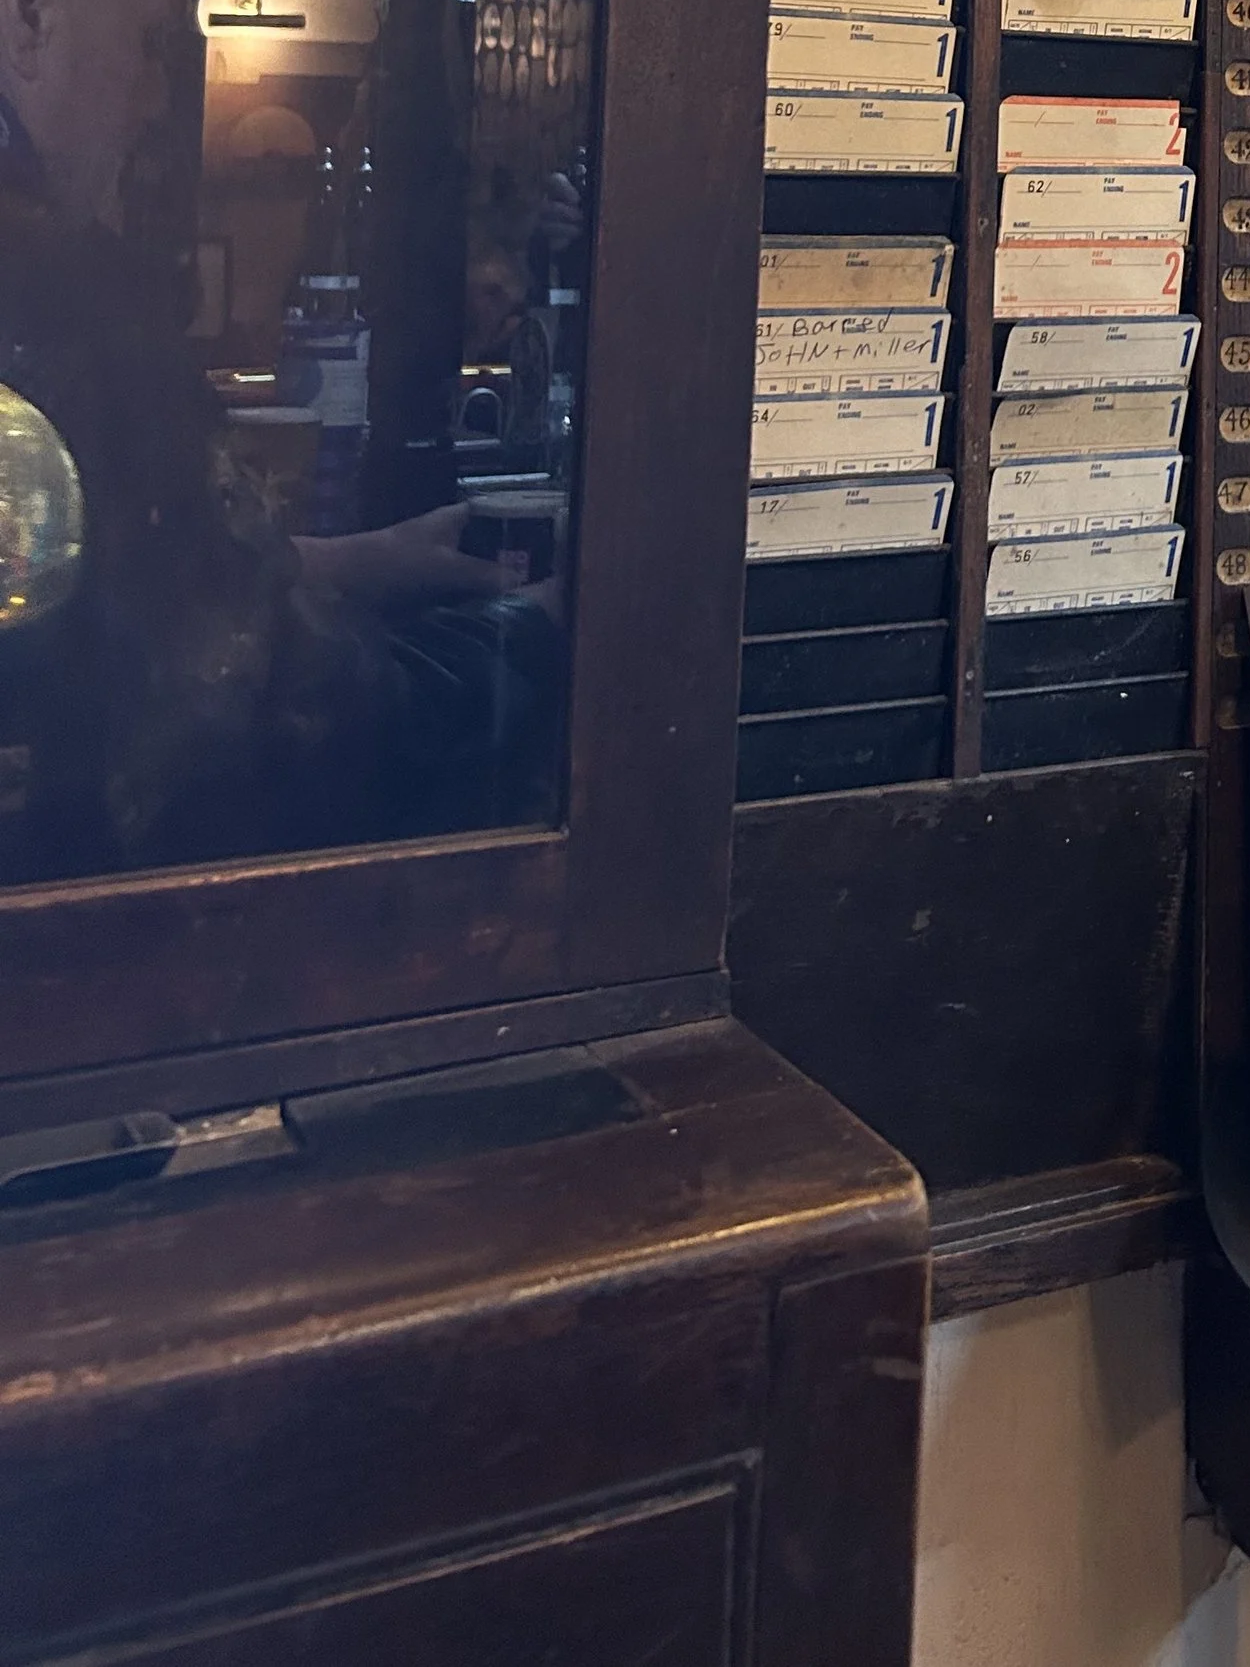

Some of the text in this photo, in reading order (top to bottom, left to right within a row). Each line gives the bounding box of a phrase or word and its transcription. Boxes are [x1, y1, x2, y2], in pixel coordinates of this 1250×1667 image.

[1224, 267, 1250, 291] 44
[1217, 481, 1248, 503] 47
[1220, 554, 1247, 576] 48
